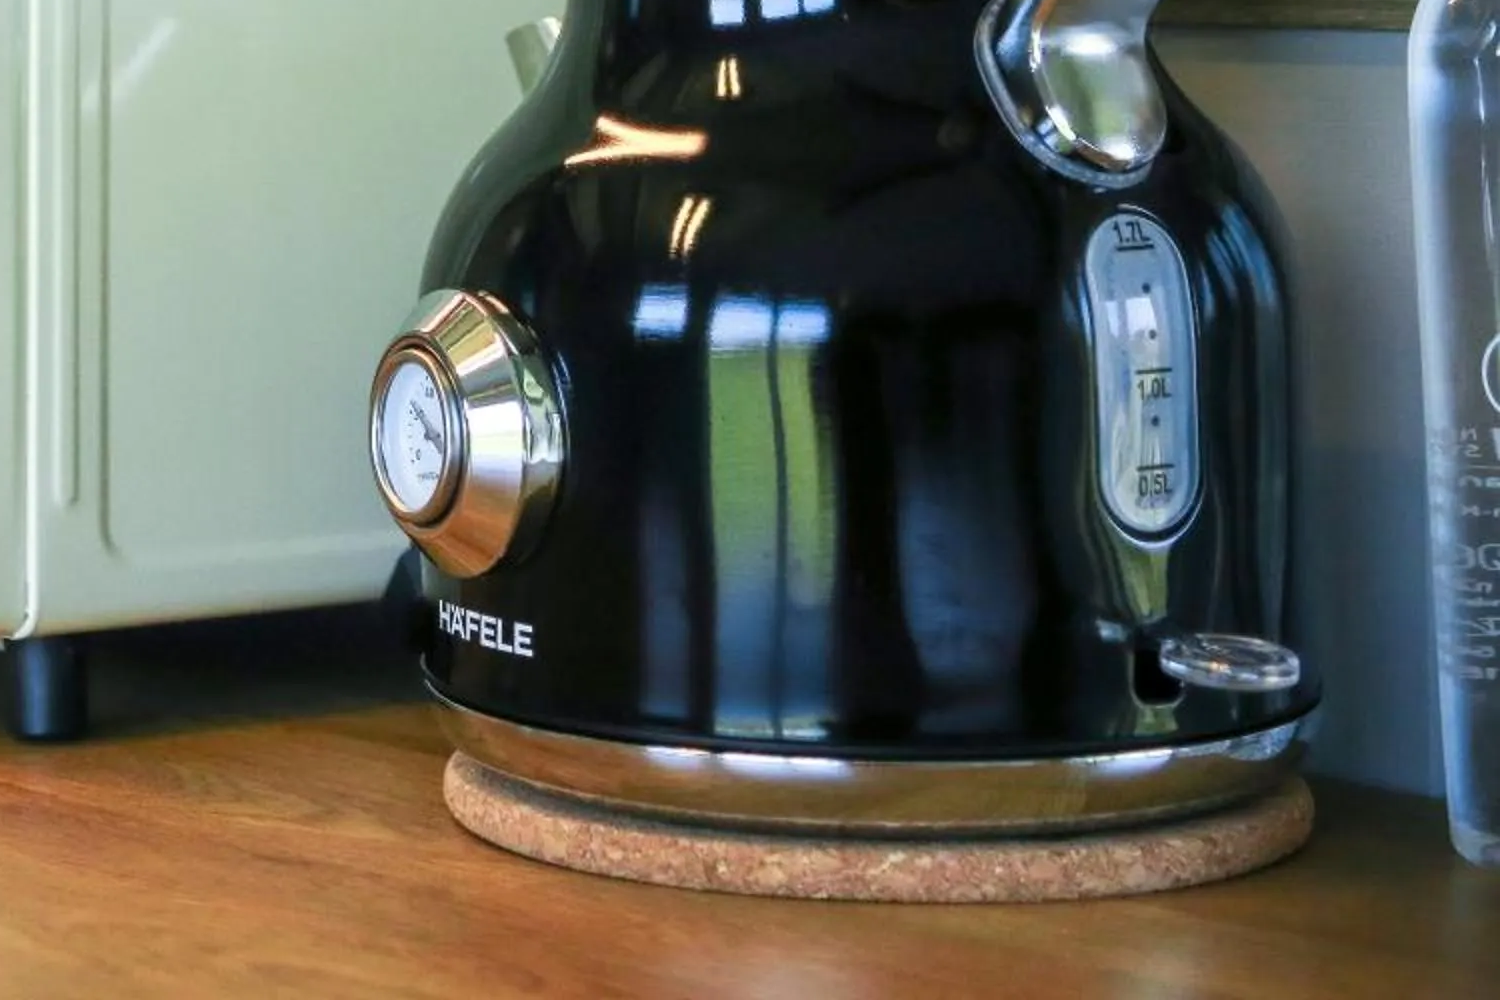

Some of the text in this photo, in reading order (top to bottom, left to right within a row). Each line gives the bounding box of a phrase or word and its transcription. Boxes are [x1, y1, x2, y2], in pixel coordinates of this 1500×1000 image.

[1113, 221, 1150, 244] 1.7L
[1137, 378, 1171, 401] 1.0L
[1138, 473, 1173, 498] 0.5L
[438, 600, 534, 657] HÄFELE
